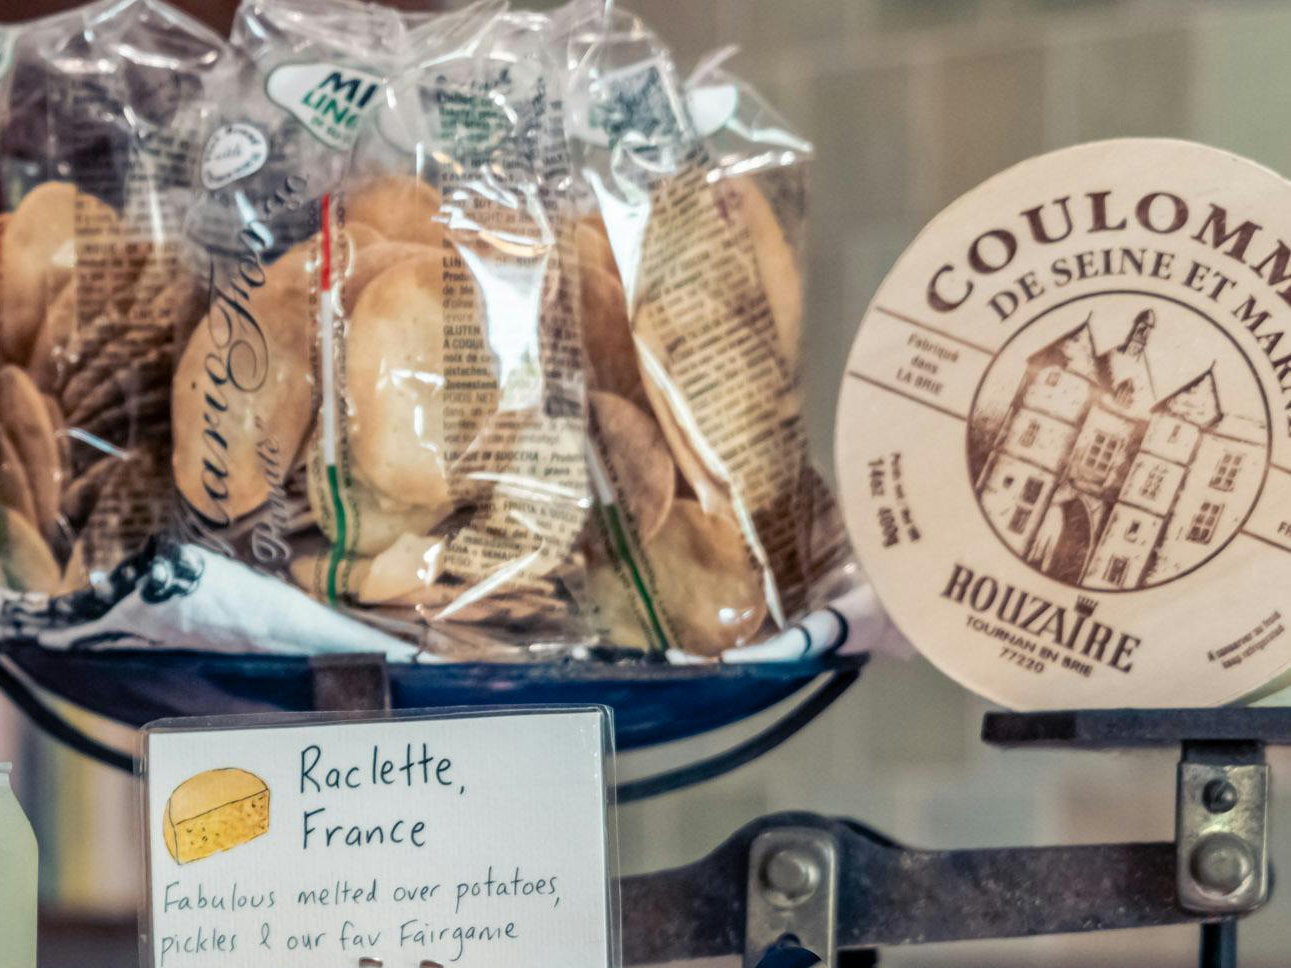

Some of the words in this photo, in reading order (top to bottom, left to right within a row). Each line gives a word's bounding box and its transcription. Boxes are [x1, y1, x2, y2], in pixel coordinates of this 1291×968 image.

[986, 270, 1046, 323] DE
[1050, 247, 1176, 288] SEINE
[1181, 259, 1238, 303] ET
[966, 615, 1037, 654] TOURNAN
[998, 647, 1046, 675] 77220
[300, 743, 465, 795] Raclette,
[303, 807, 426, 850] France
[163, 880, 277, 914] Fabulous
[297, 880, 378, 906] melted
[393, 884, 442, 903] over
[455, 866, 561, 914] potatoes,
[160, 926, 237, 967] pickles
[287, 930, 328, 950] our
[338, 921, 383, 951] fav
